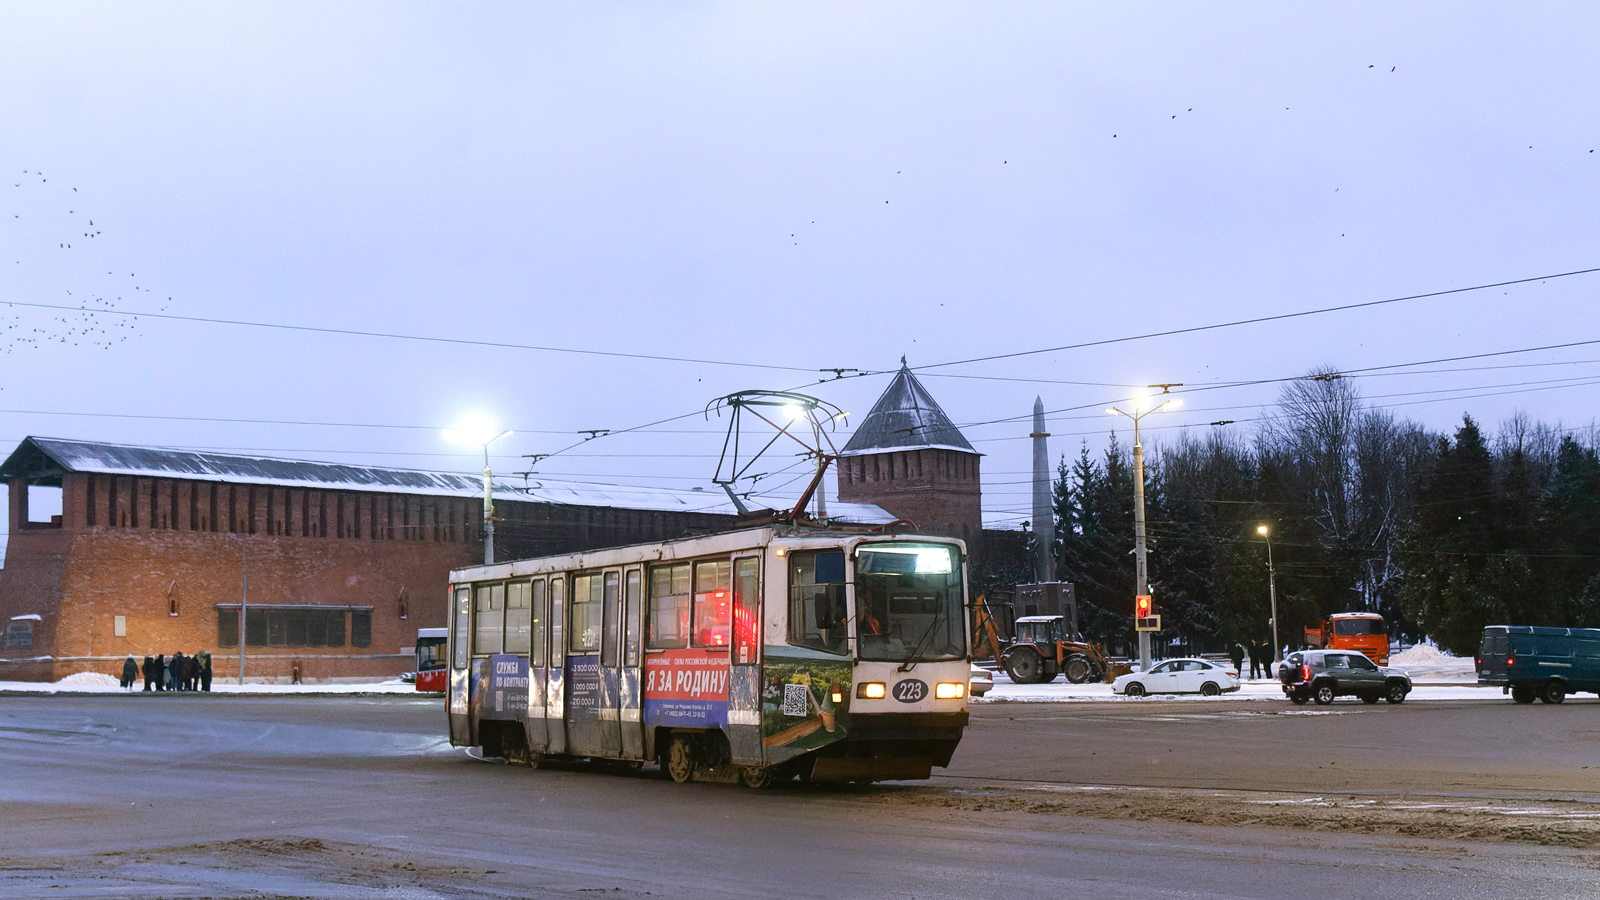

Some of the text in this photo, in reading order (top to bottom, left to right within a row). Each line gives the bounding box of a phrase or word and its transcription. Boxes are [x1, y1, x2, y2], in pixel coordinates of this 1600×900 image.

[496, 661, 519, 675] СЛУЖБА
[646, 670, 727, 697] Я ЗА РОДИНУ
[899, 682, 922, 700] 223
